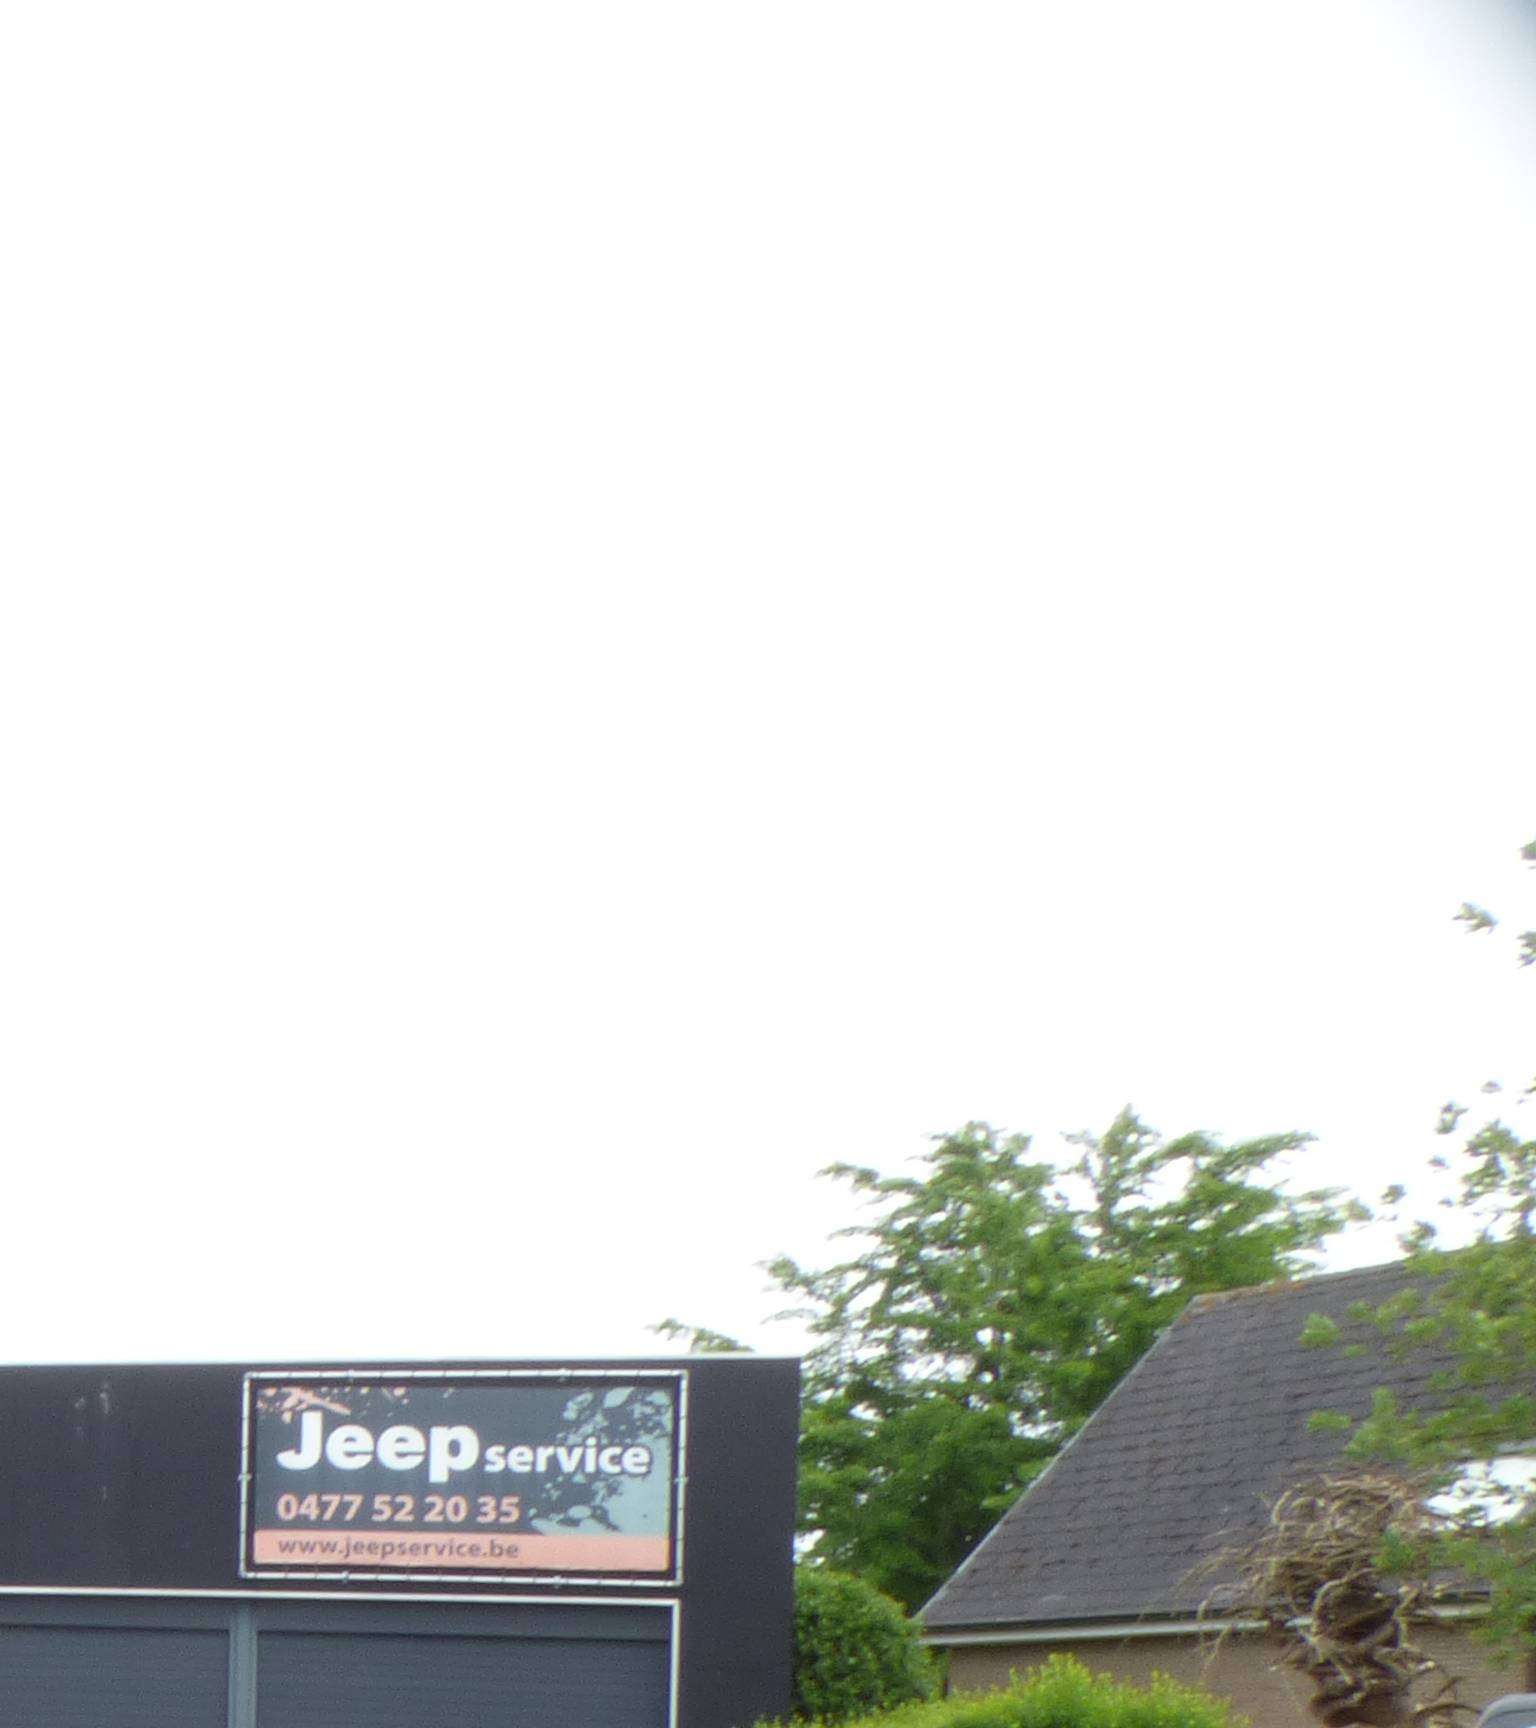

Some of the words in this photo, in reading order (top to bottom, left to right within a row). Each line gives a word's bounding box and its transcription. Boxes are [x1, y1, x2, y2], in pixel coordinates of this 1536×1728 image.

[276, 1411, 480, 1483] Jeep
[484, 1437, 651, 1474] service
[277, 1494, 364, 1522] 0477
[371, 1495, 415, 1522] 52
[424, 1496, 468, 1523] 20
[476, 1497, 521, 1524] 35
[278, 1537, 520, 1560] www.jeepservice.be
